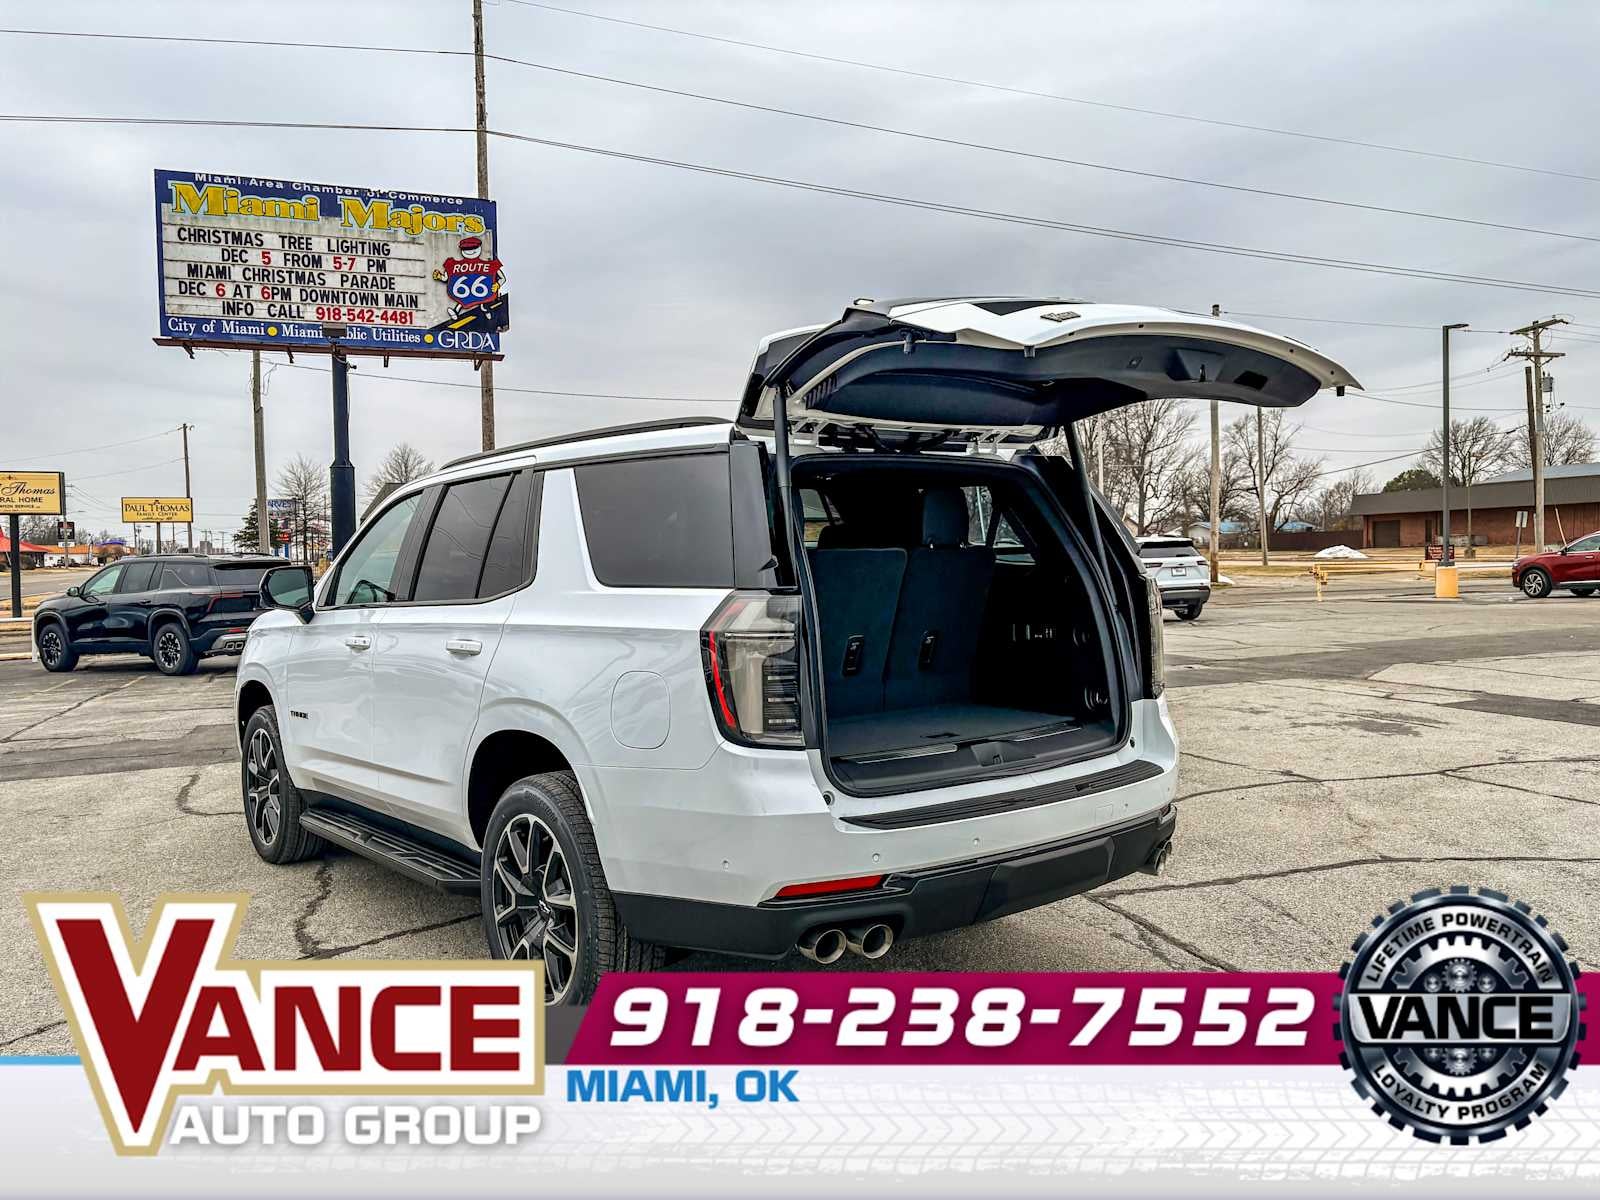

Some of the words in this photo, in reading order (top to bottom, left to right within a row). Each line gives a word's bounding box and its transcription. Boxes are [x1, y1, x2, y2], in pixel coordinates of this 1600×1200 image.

[194, 173, 242, 185] Miami
[249, 177, 284, 189] Area
[292, 182, 359, 195] Chamber
[388, 191, 463, 205] Commerce
[171, 182, 320, 221] Miami
[340, 197, 485, 236] Majors
[177, 227, 264, 247] CHRISTMAS
[279, 235, 313, 251] TREE
[327, 239, 391, 256] LIGHTING
[221, 248, 249, 263] DEC
[261, 251, 271, 265] 5
[284, 253, 322, 269] FROM
[333, 256, 357, 270] 5-7
[367, 259, 387, 273] PM
[452, 263, 491, 274] ROUTE
[187, 264, 232, 280] MIAMI
[242, 268, 326, 286] CHRISTMAS
[340, 274, 396, 290] PARADE
[452, 275, 489, 299] 66
[178, 281, 206, 296] DEC
[215, 283, 226, 297] 6
[233, 285, 253, 298] AT
[261, 285, 292, 301] 6PM
[300, 289, 379, 306] DOWNTOWN
[385, 294, 418, 309] MAIN
[222, 301, 254, 316] INFO
[267, 303, 304, 319] CALL
[316, 306, 414, 324] 918-542-4481
[168, 317, 196, 335] City
[202, 320, 217, 333] of
[222, 321, 265, 336] Miami
[281, 323, 323, 339] Miami
[328, 326, 367, 340] blic
[372, 328, 420, 343] Utilities
[438, 330, 495, 350] GRDA
[1, 481, 55, 496] Thomas
[124, 503, 145, 512] PAUL
[148, 503, 190, 512] THOMAS
